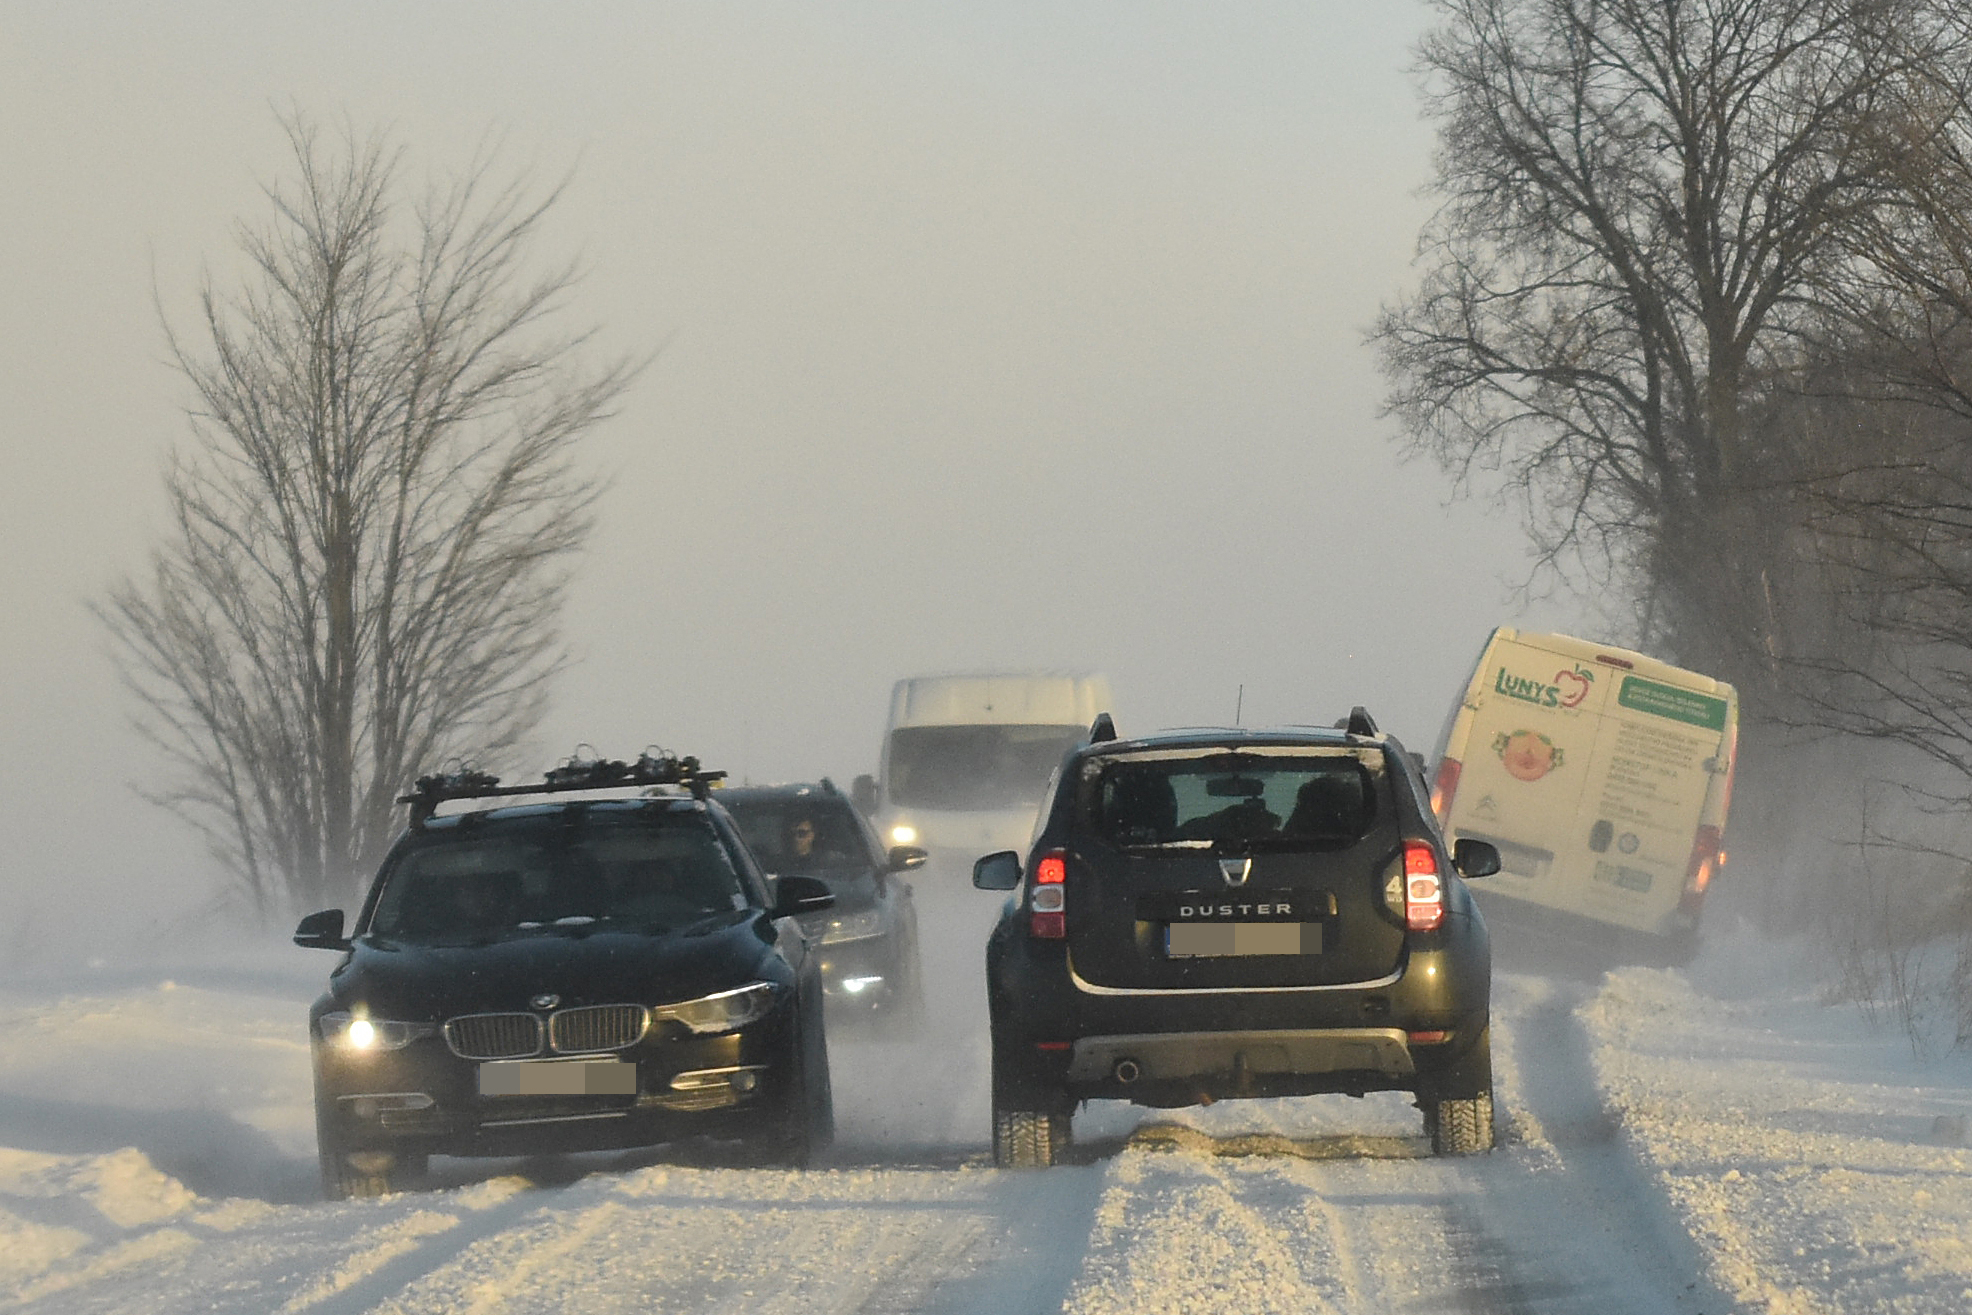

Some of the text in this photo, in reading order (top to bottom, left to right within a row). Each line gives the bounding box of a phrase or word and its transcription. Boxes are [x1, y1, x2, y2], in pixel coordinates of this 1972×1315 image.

[1495, 667, 1560, 707] LUNYS
[1386, 876, 1402, 893] 4
[1180, 904, 1292, 917] DUSTER
